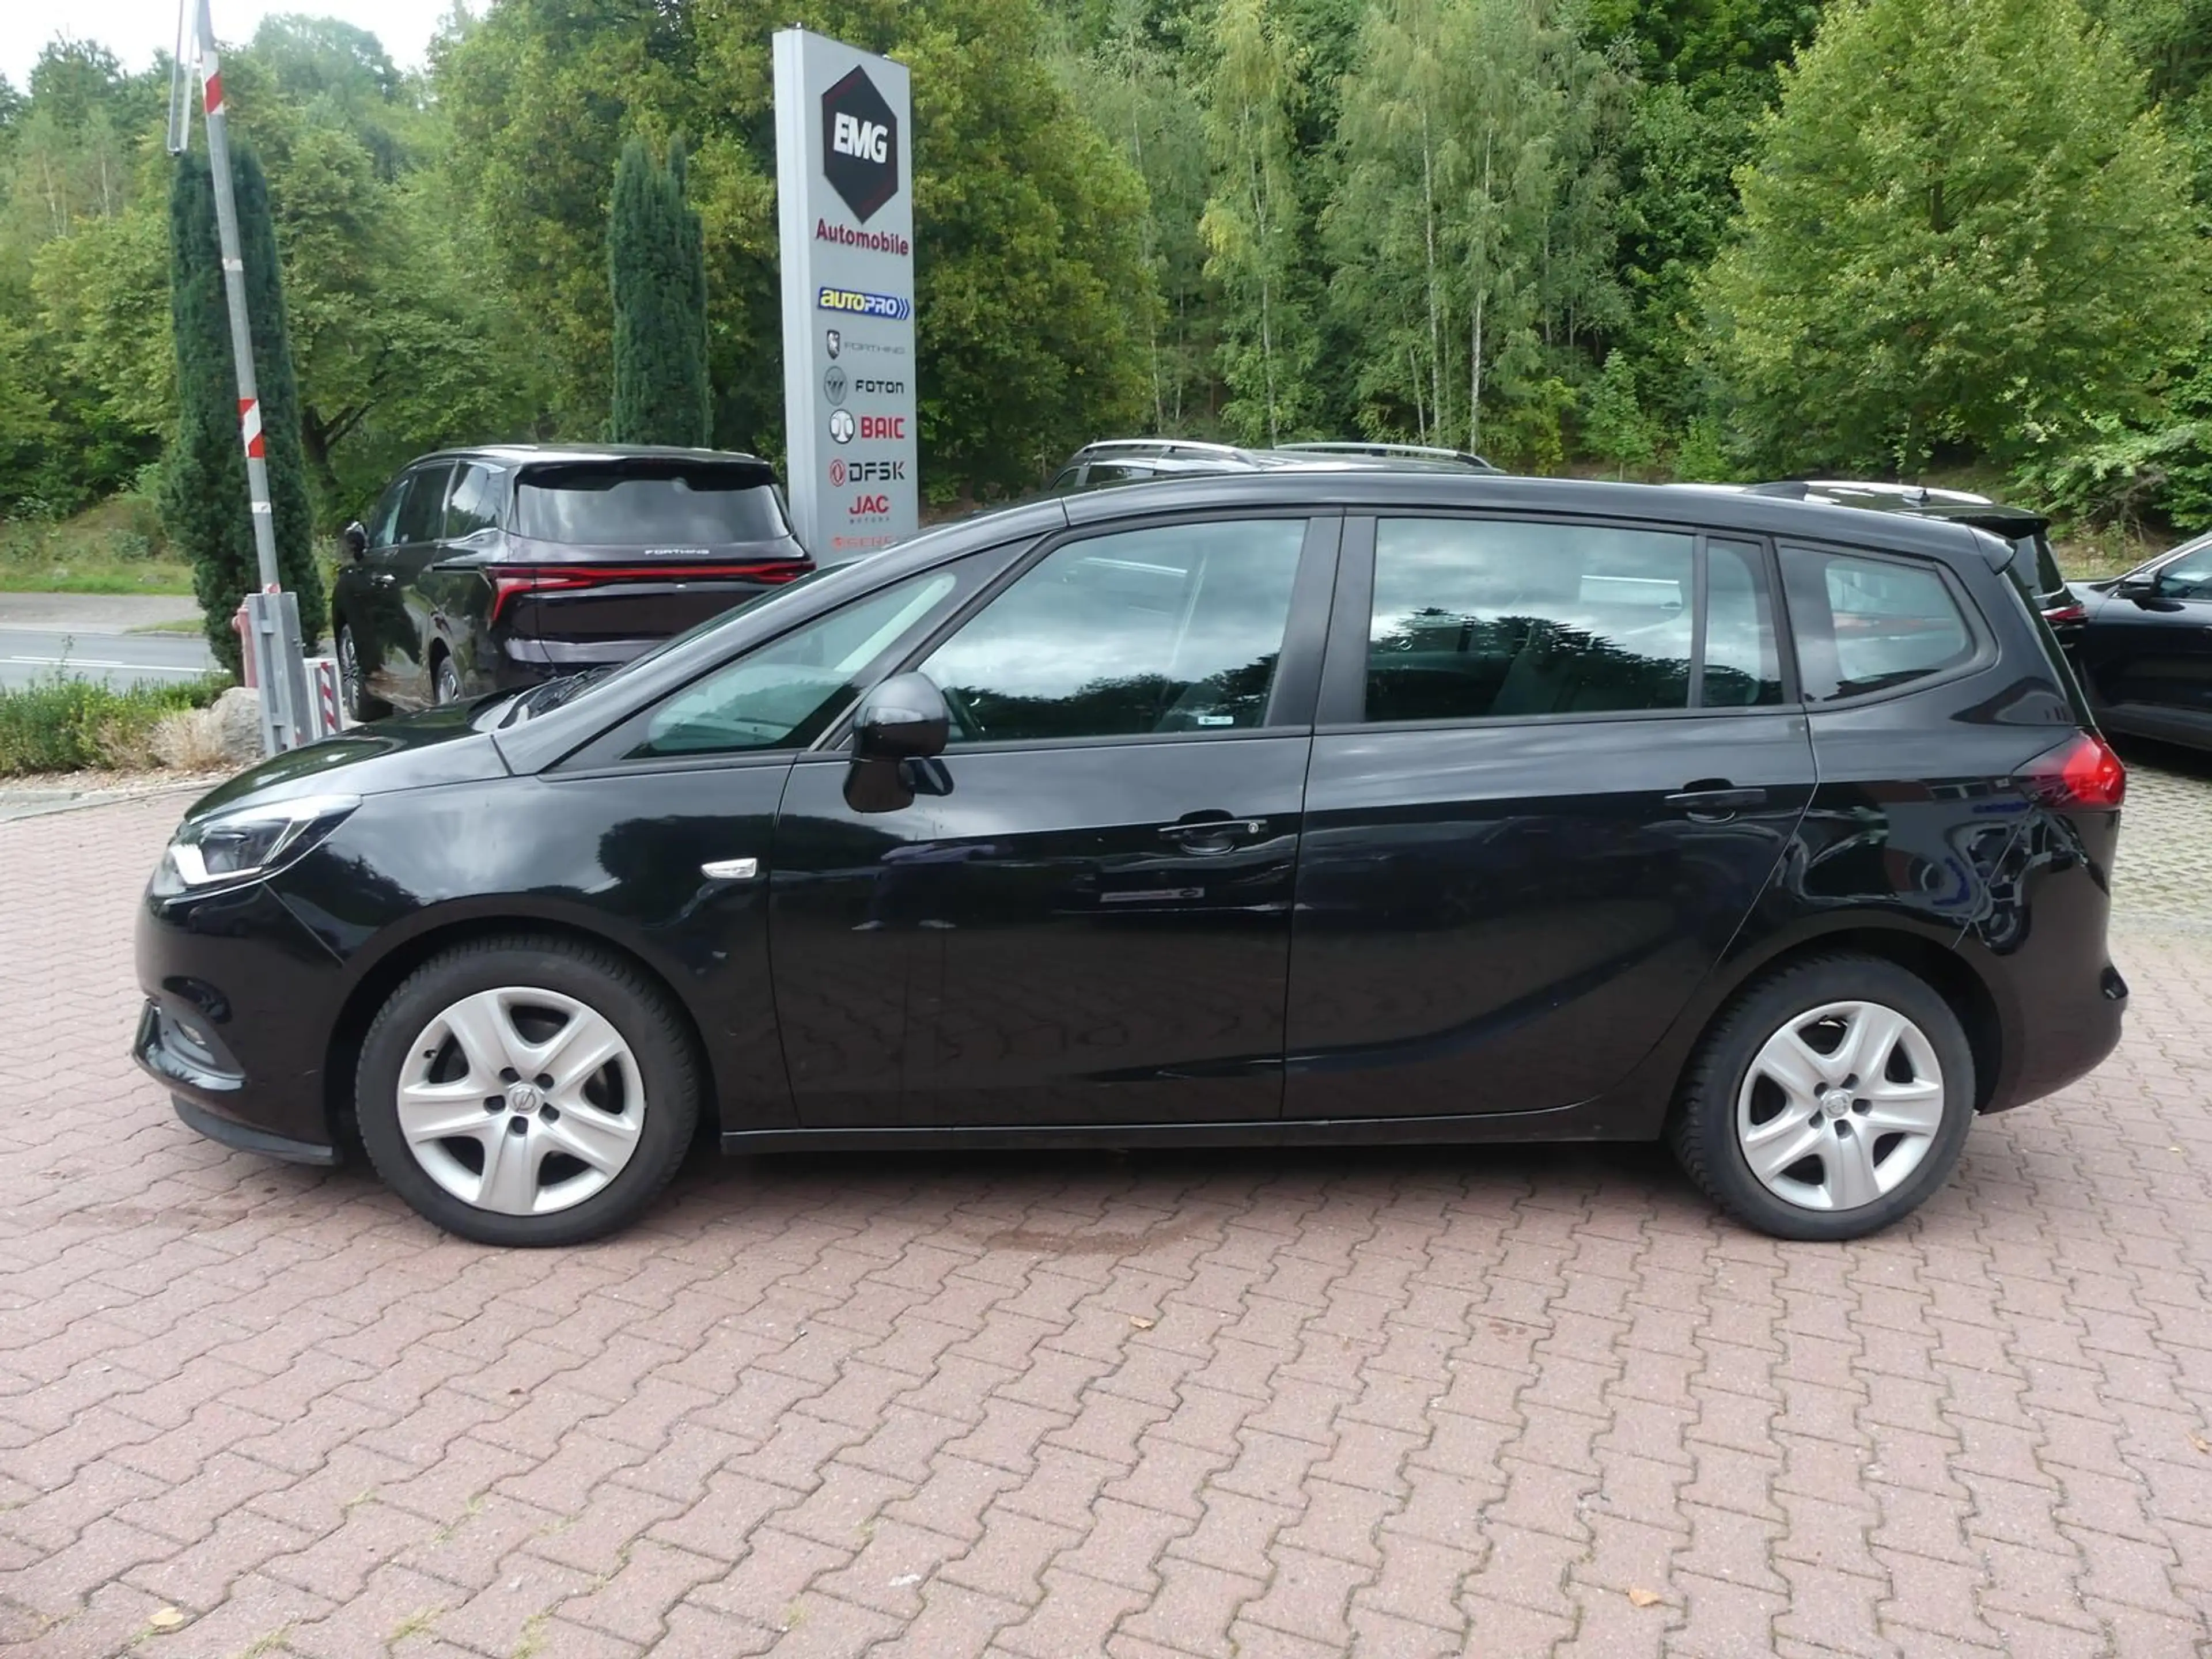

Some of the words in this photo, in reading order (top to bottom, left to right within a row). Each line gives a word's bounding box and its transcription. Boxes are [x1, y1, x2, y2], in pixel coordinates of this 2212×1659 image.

[834, 112, 888, 163] EMG
[816, 218, 909, 256] Automobile
[861, 416, 905, 439] BAIC
[849, 461, 905, 482] DFSK
[849, 495, 890, 514] JAC
